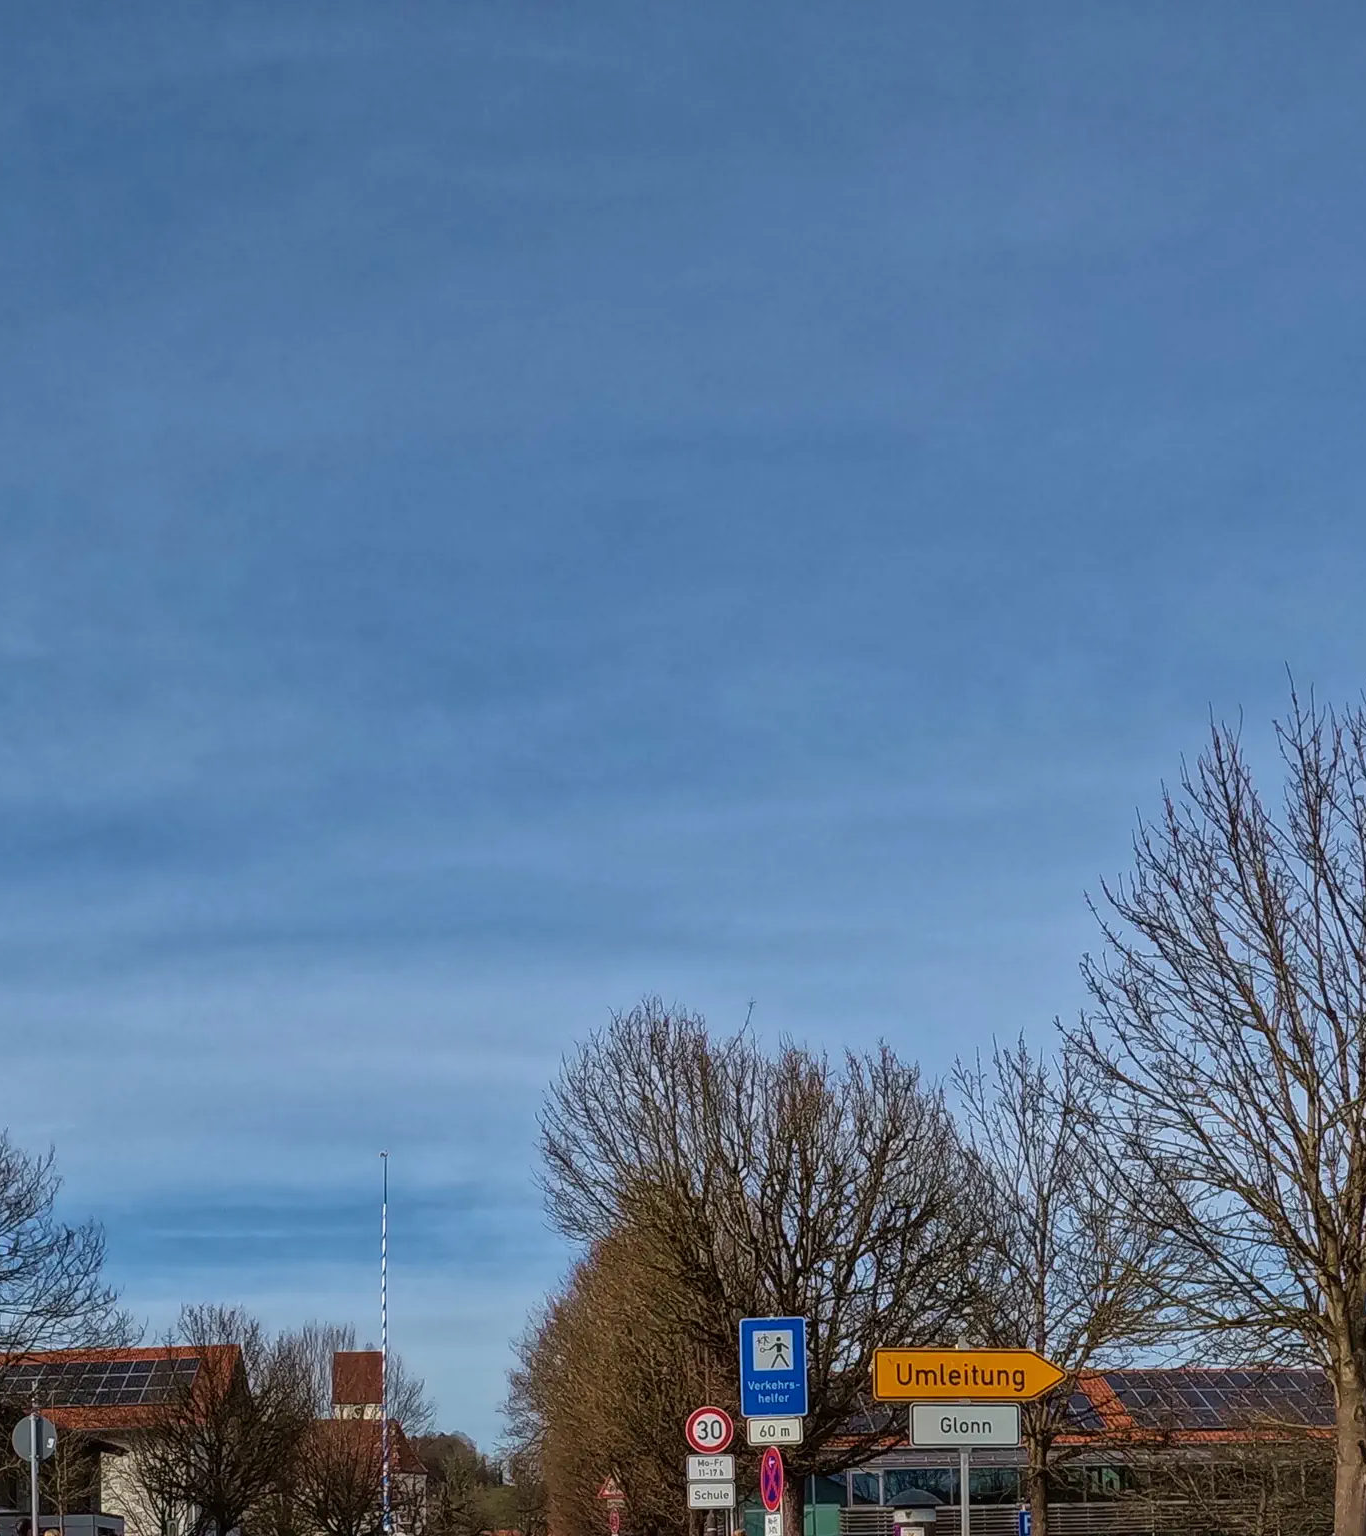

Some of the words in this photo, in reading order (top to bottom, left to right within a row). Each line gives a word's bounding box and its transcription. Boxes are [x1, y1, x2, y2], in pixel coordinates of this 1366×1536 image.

[896, 1363, 1026, 1393] Umleitung
[747, 1380, 800, 1391] Verkehrs-
[757, 1393, 790, 1404] helfer
[696, 1419, 723, 1441] 30
[759, 1424, 776, 1438] 60
[780, 1427, 791, 1437] m
[940, 1416, 992, 1434] Glonn
[697, 1458, 724, 1467] Mo-Fr
[694, 1490, 730, 1501] Schule
